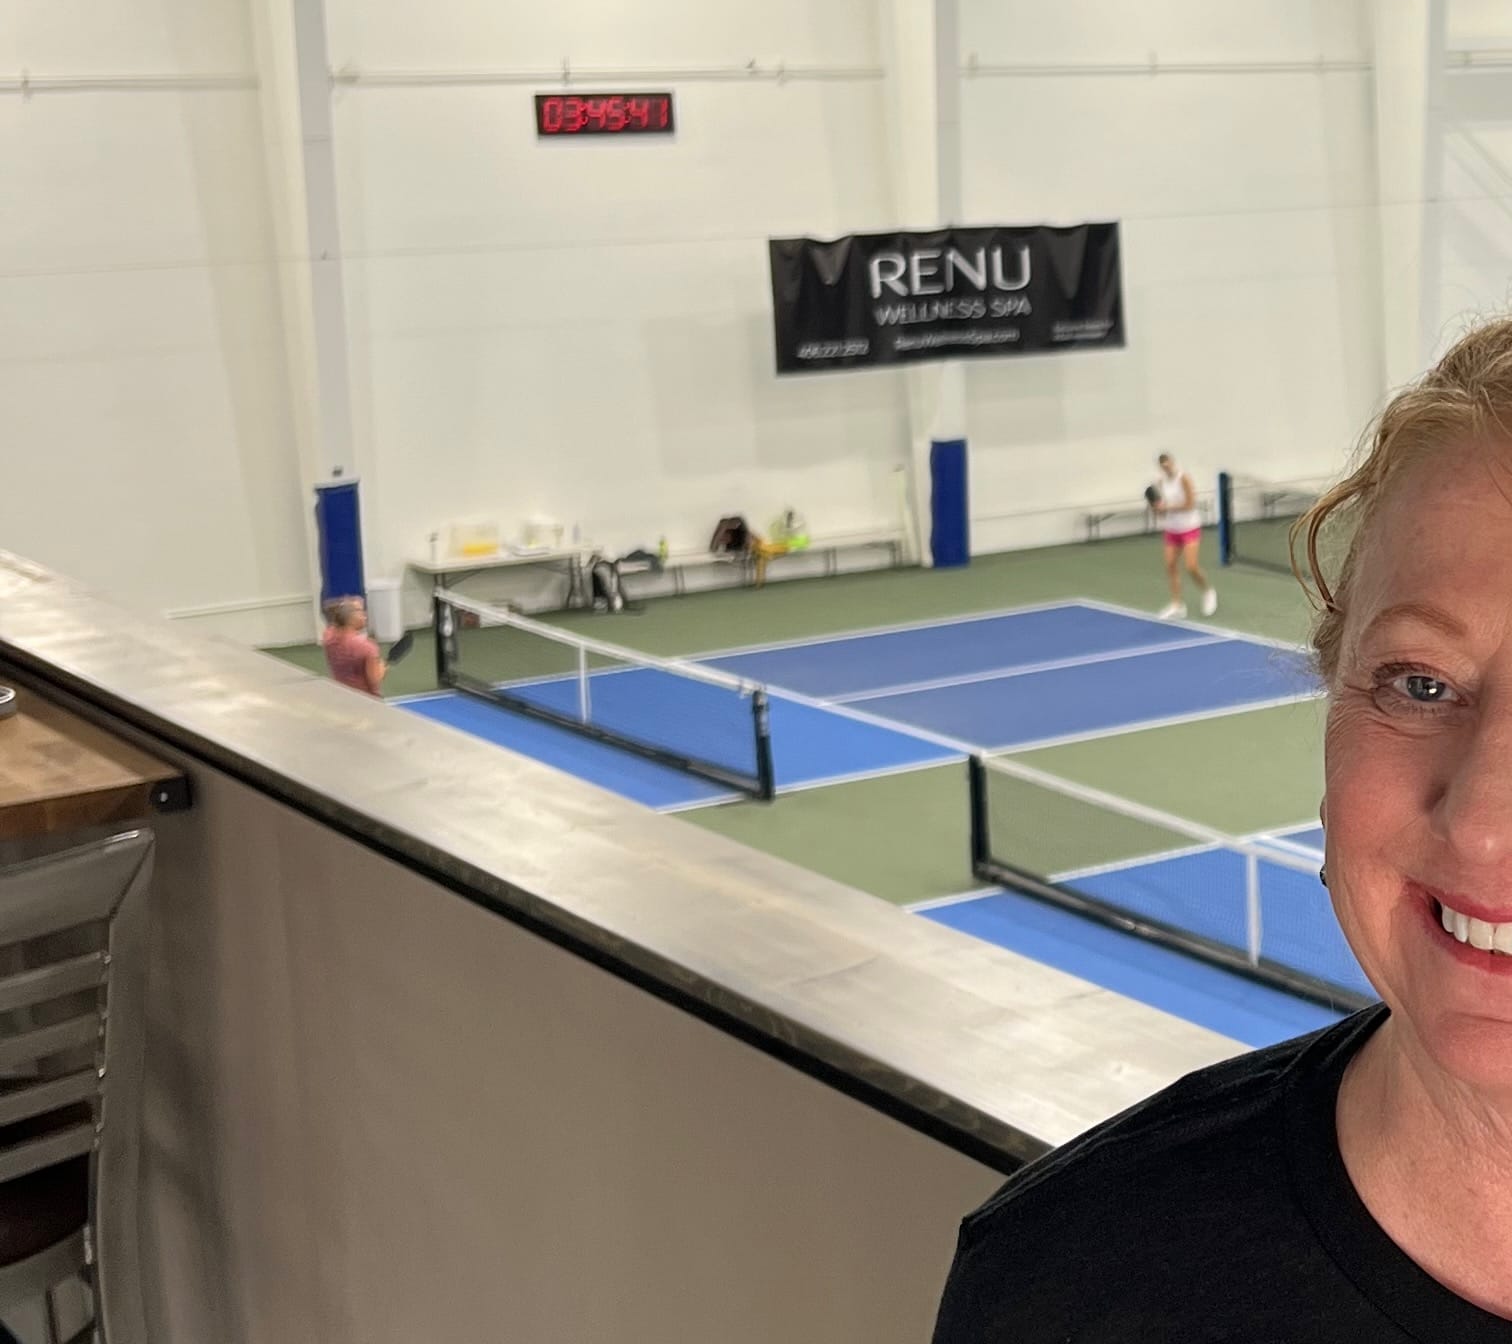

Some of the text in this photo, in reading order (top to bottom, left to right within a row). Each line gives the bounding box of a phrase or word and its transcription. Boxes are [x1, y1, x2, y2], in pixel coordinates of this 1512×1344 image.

[542, 96, 669, 132] 03:45:41
[869, 244, 1032, 299] RENU
[874, 295, 1033, 326] WELLNESS SPA
